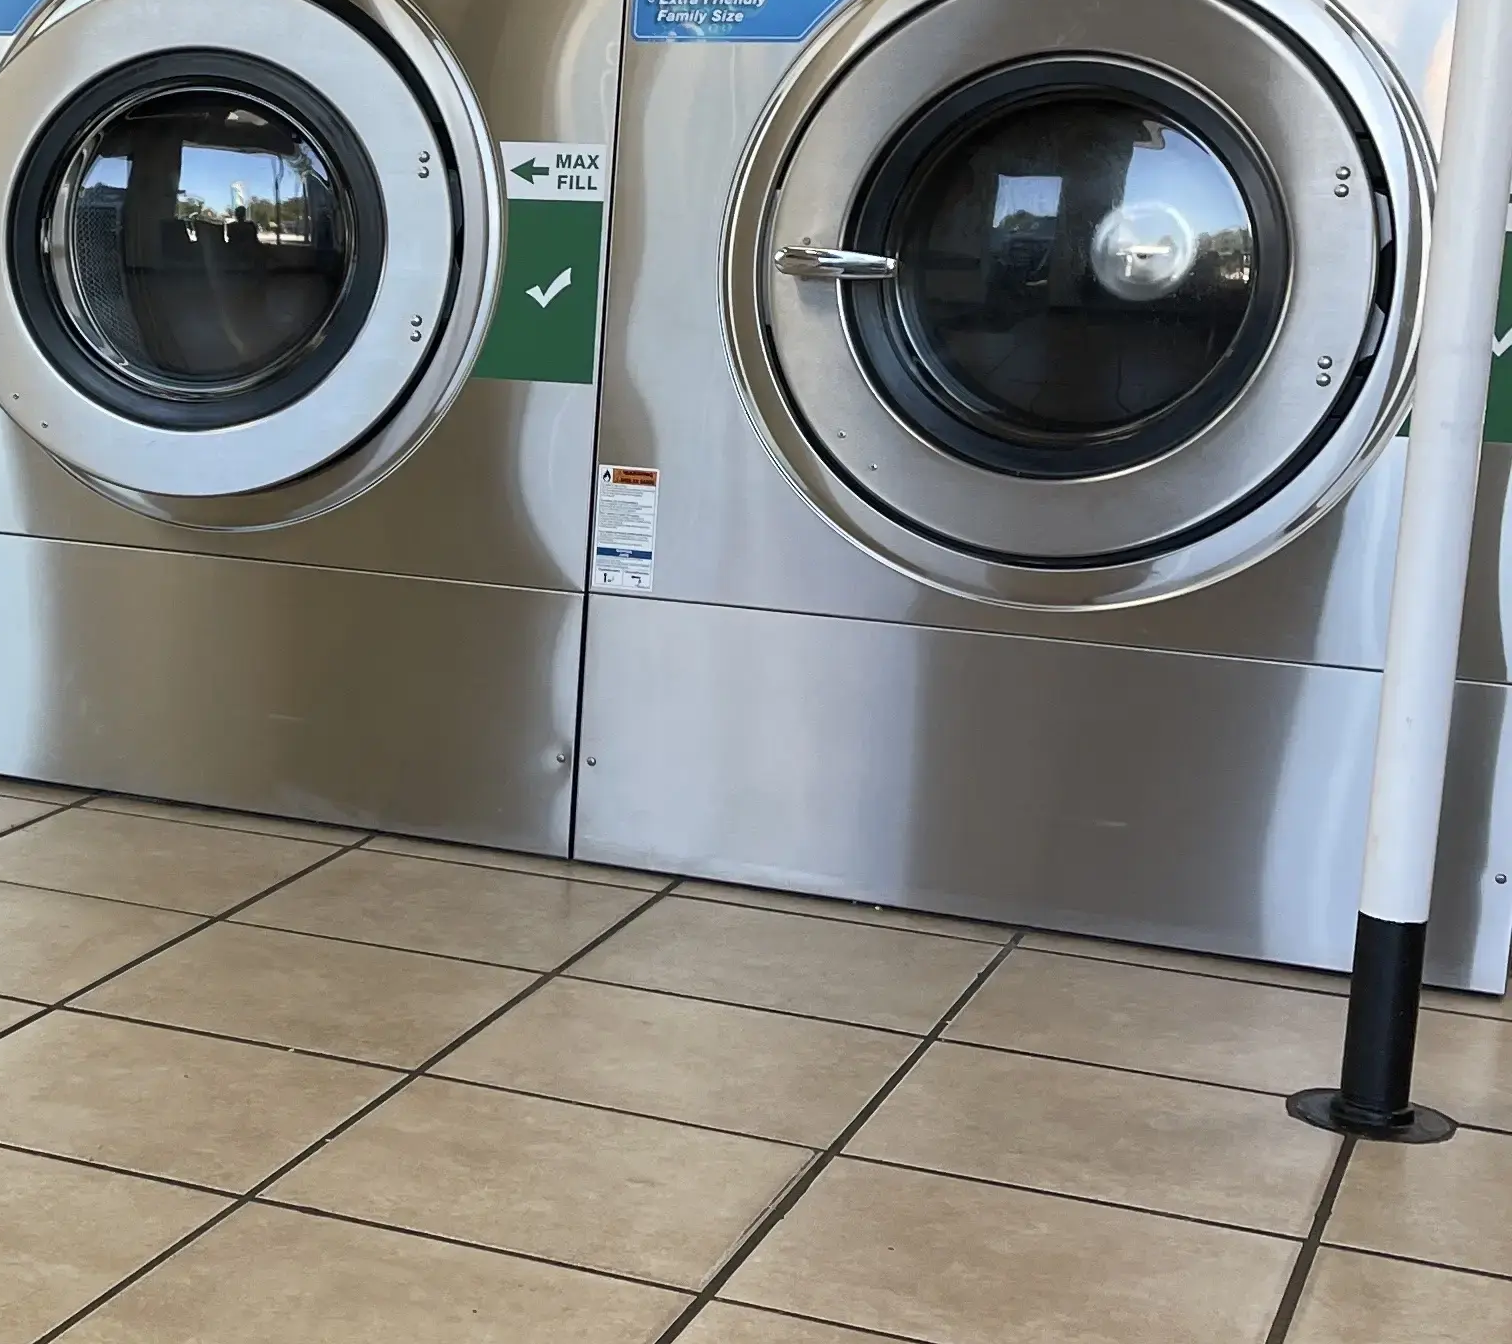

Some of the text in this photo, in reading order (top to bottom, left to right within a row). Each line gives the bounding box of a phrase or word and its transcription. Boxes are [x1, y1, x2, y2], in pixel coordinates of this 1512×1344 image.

[657, 10, 744, 24] Family Size
[555, 154, 600, 170] MAX
[557, 175, 598, 190] FILL
